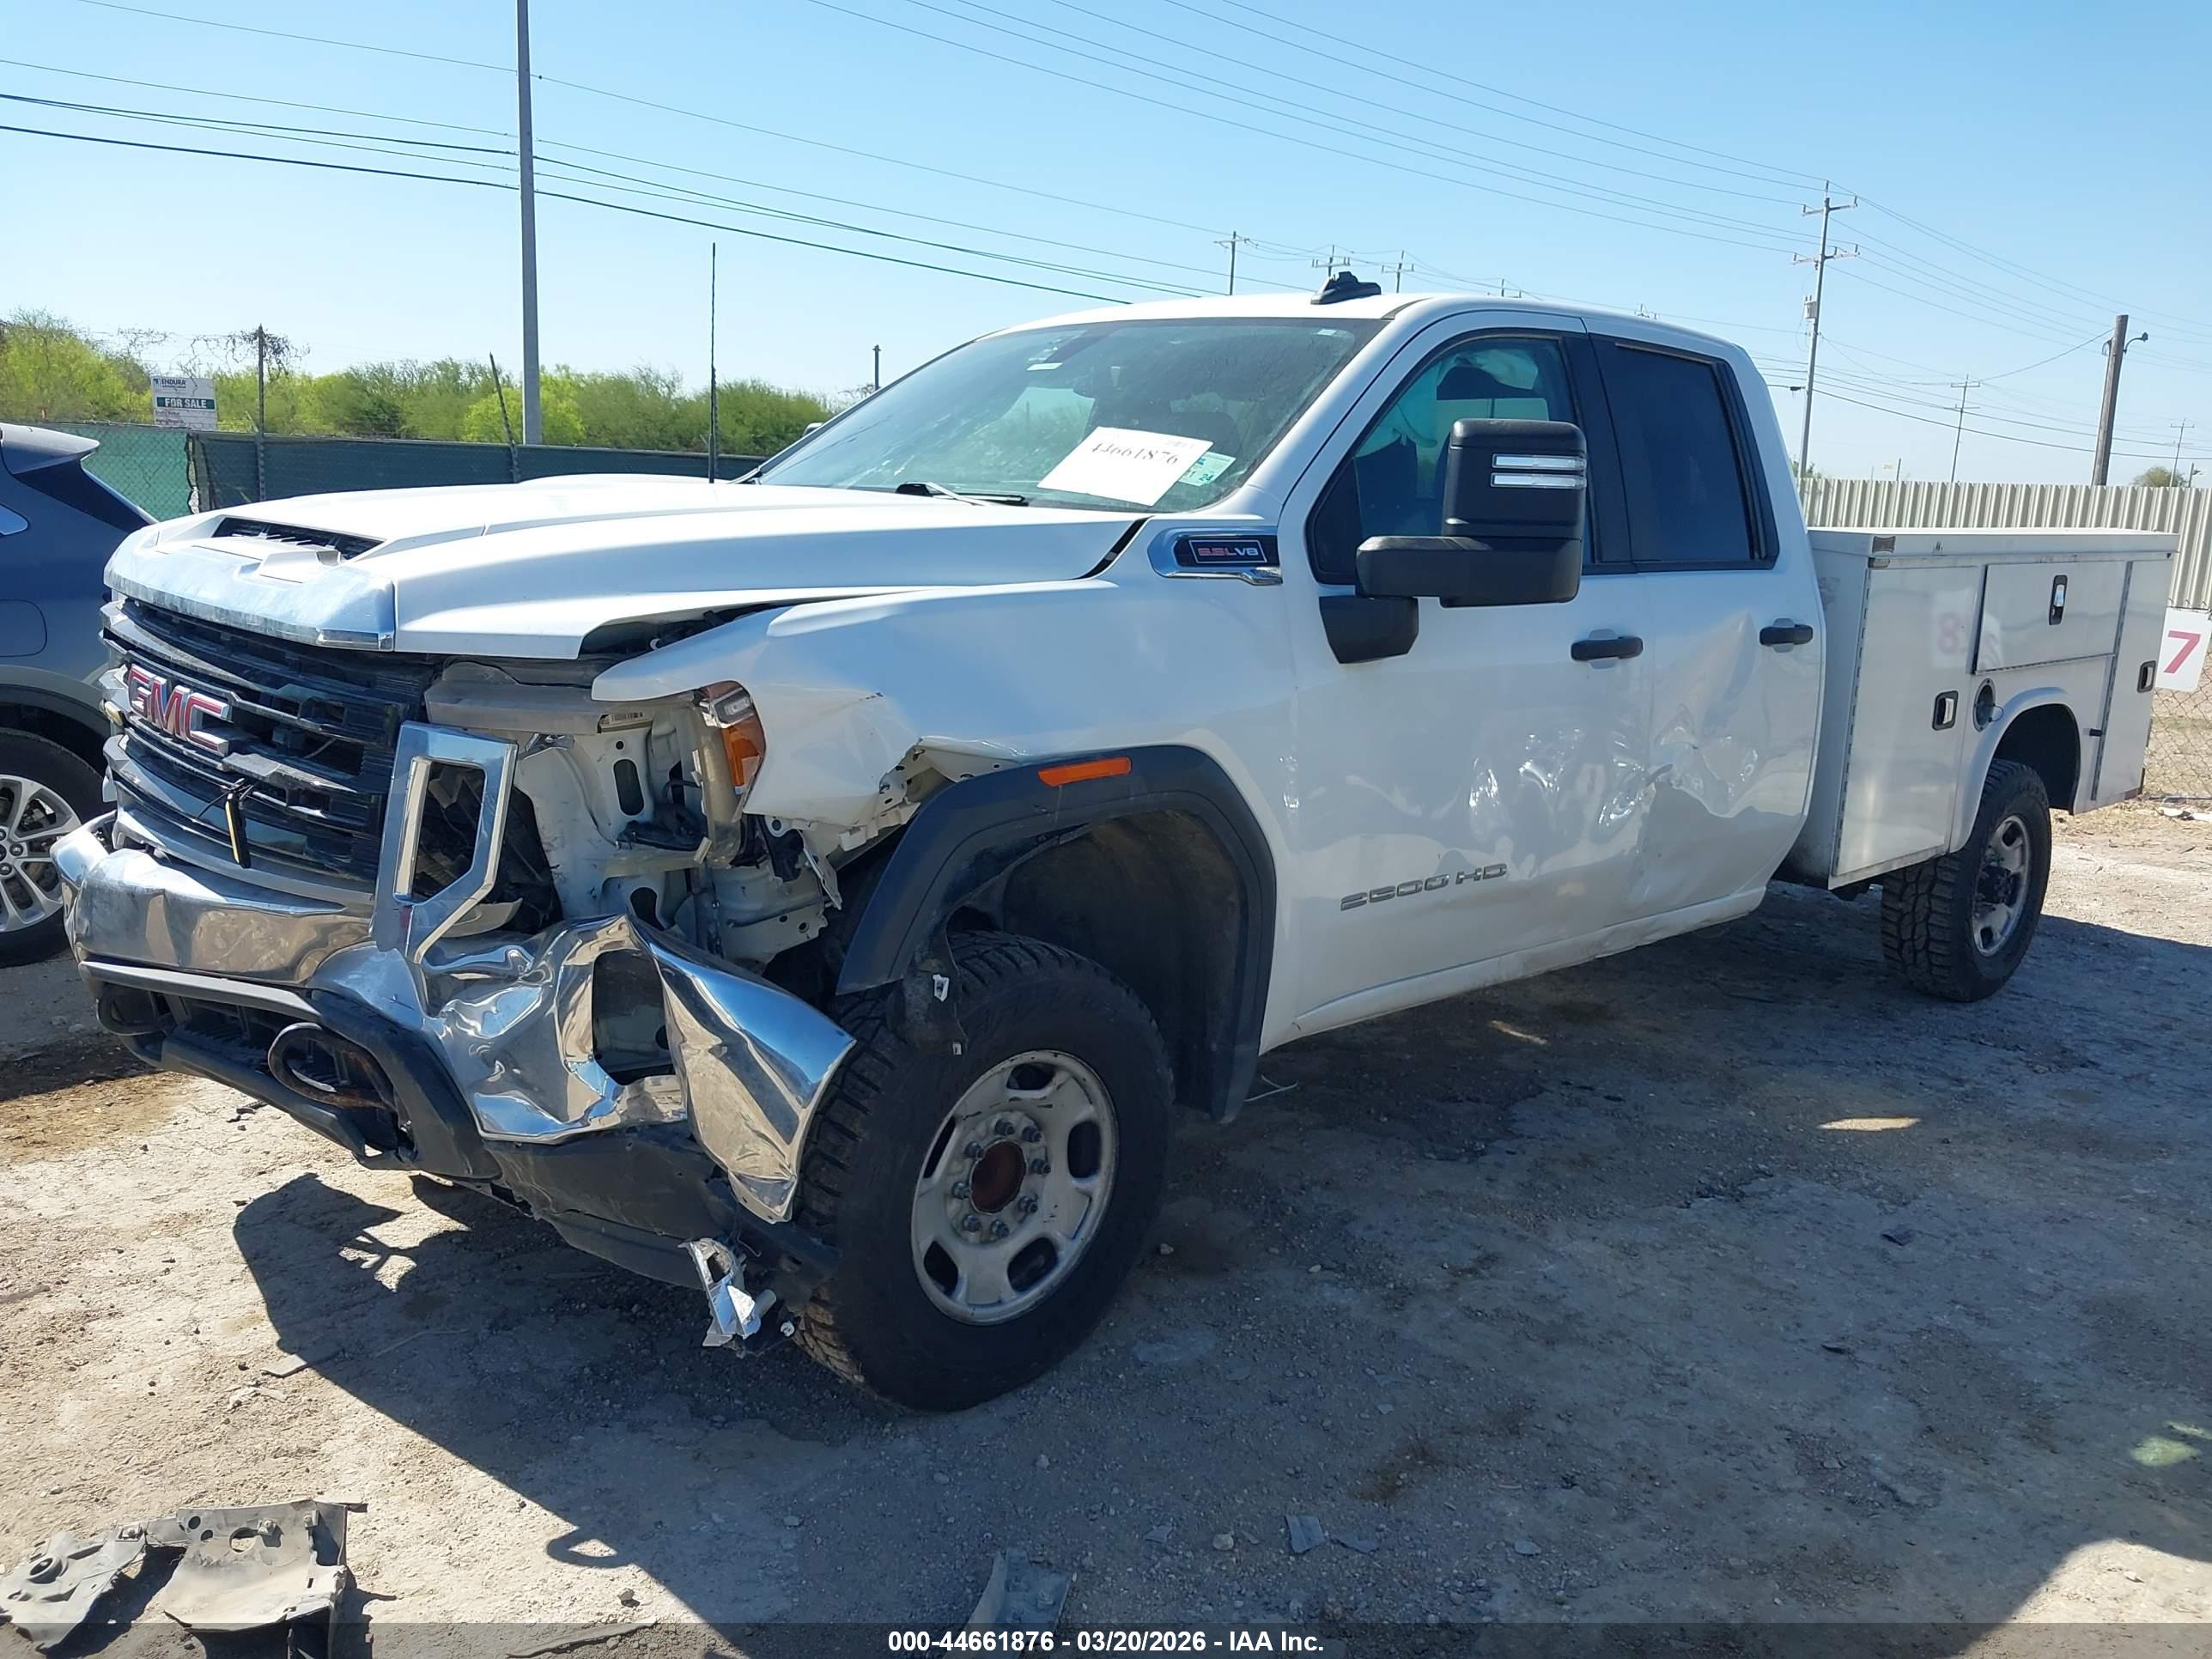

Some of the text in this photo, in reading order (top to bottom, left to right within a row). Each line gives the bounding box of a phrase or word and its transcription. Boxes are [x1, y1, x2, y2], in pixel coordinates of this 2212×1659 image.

[165, 398, 207, 409] FOR SALE
[1091, 442, 1179, 465] 44661876
[2164, 630, 2201, 674] 7
[128, 663, 229, 757] GMC
[1340, 863, 1507, 912] 2500 HD
